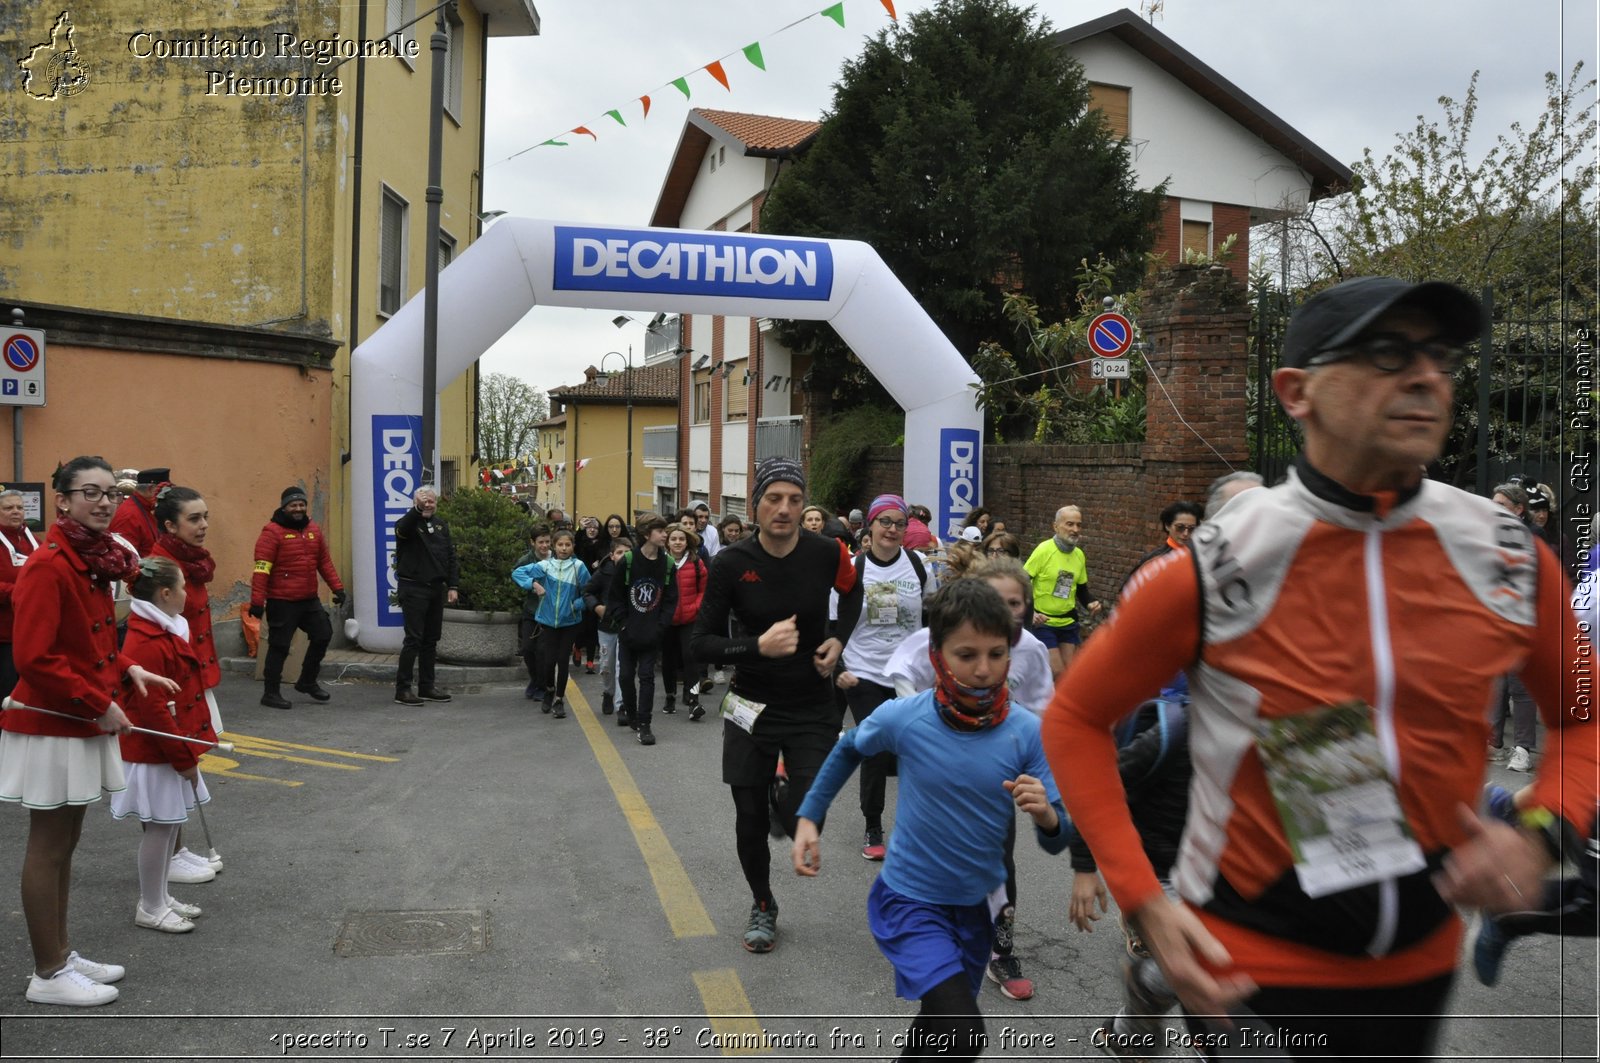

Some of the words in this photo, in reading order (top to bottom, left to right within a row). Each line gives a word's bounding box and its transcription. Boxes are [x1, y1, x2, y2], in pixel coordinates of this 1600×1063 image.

[572, 237, 817, 287] DECATHLON
[1106, 365, 1125, 373] 0-24
[7, 381, 14, 393] P
